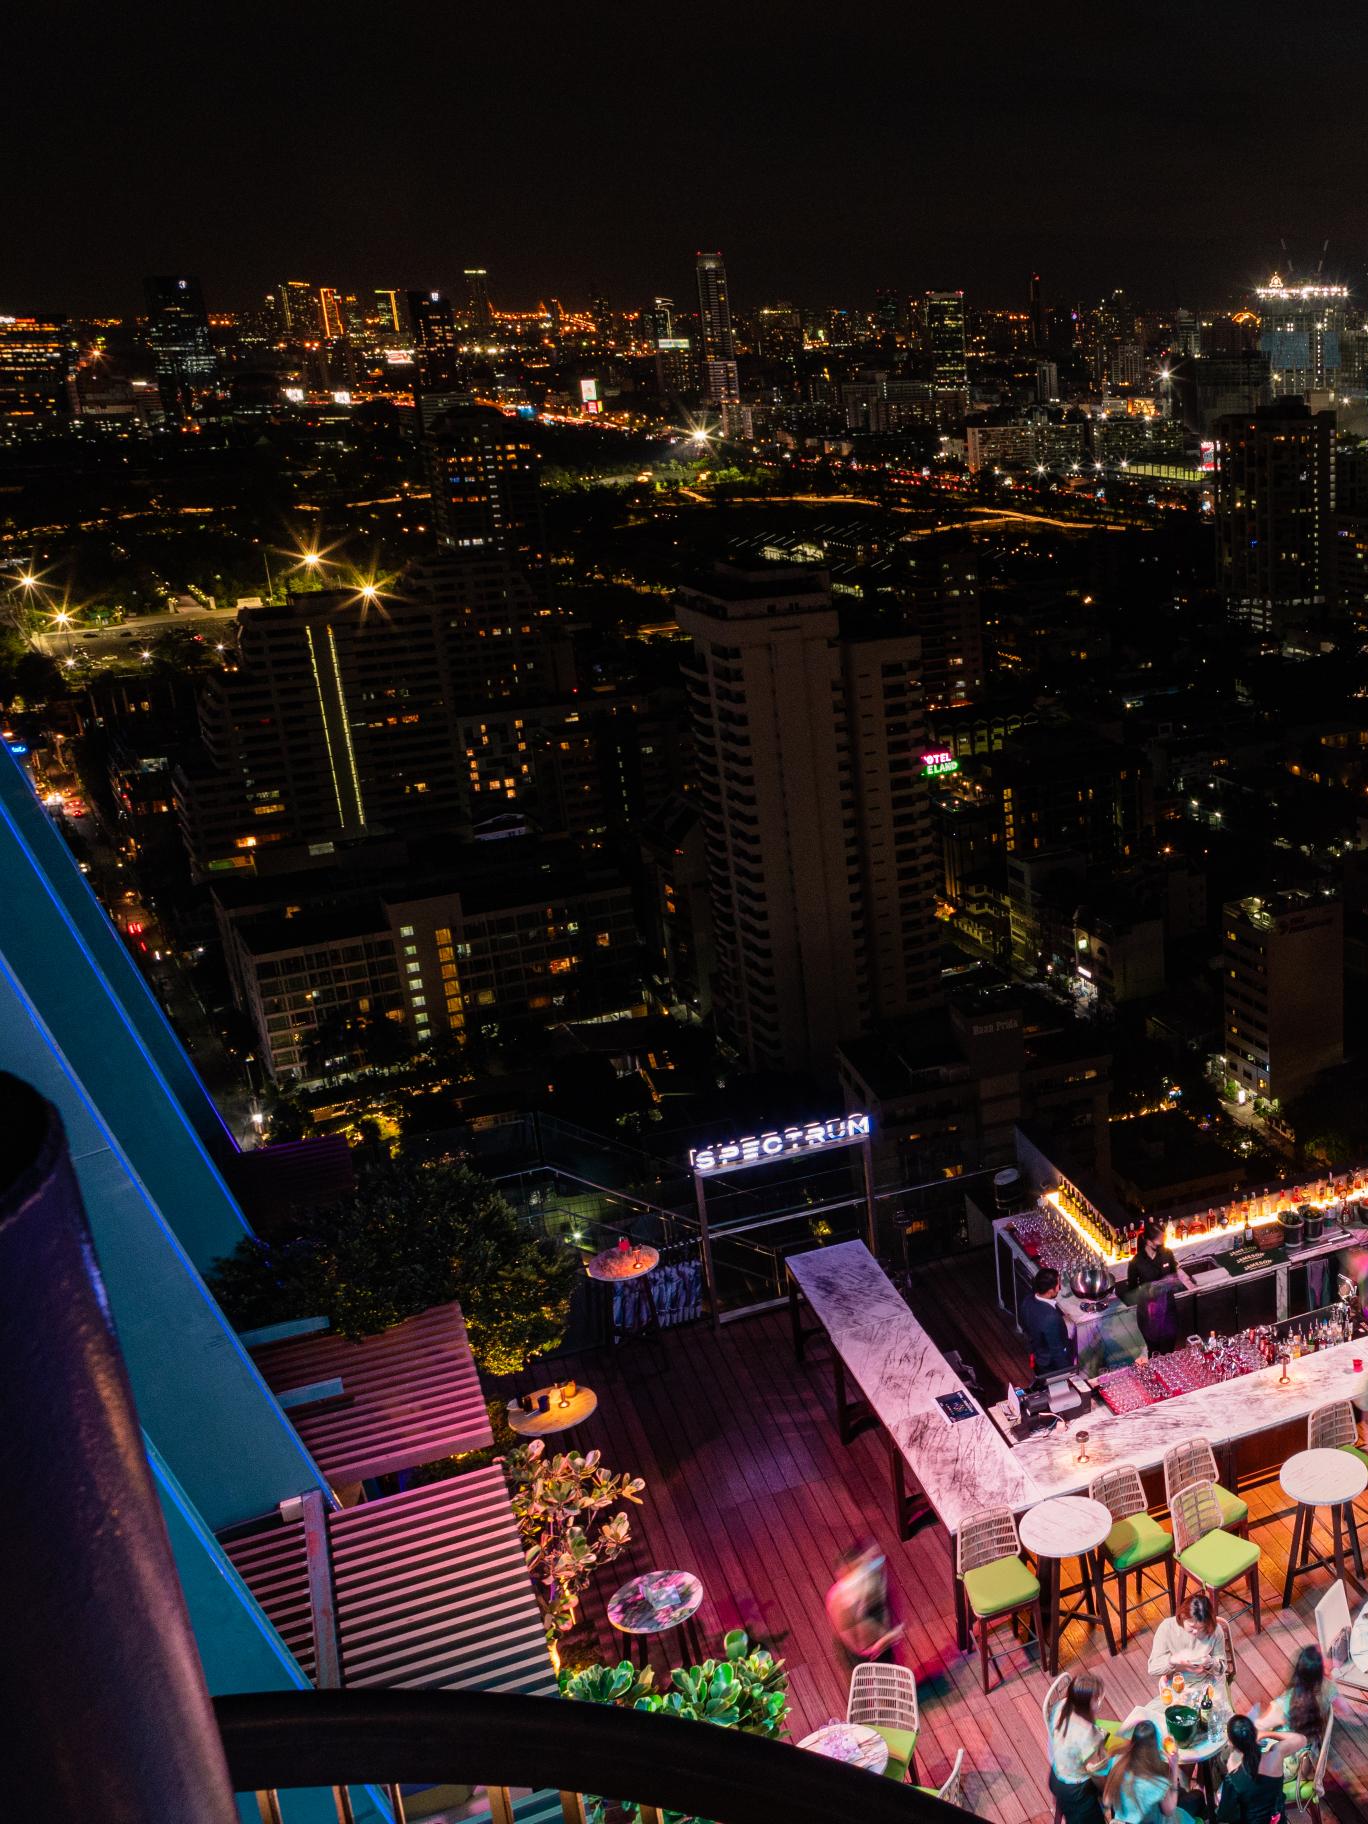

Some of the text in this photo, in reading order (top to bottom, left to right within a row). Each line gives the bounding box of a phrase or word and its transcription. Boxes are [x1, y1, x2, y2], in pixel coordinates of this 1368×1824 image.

[923, 752, 952, 764] OTEL
[927, 761, 958, 775] ELAND
[693, 1114, 870, 1170] SPECTRUM
[1236, 1252, 1265, 1264] JAMESON
[1244, 1259, 1272, 1270] JAMESON
